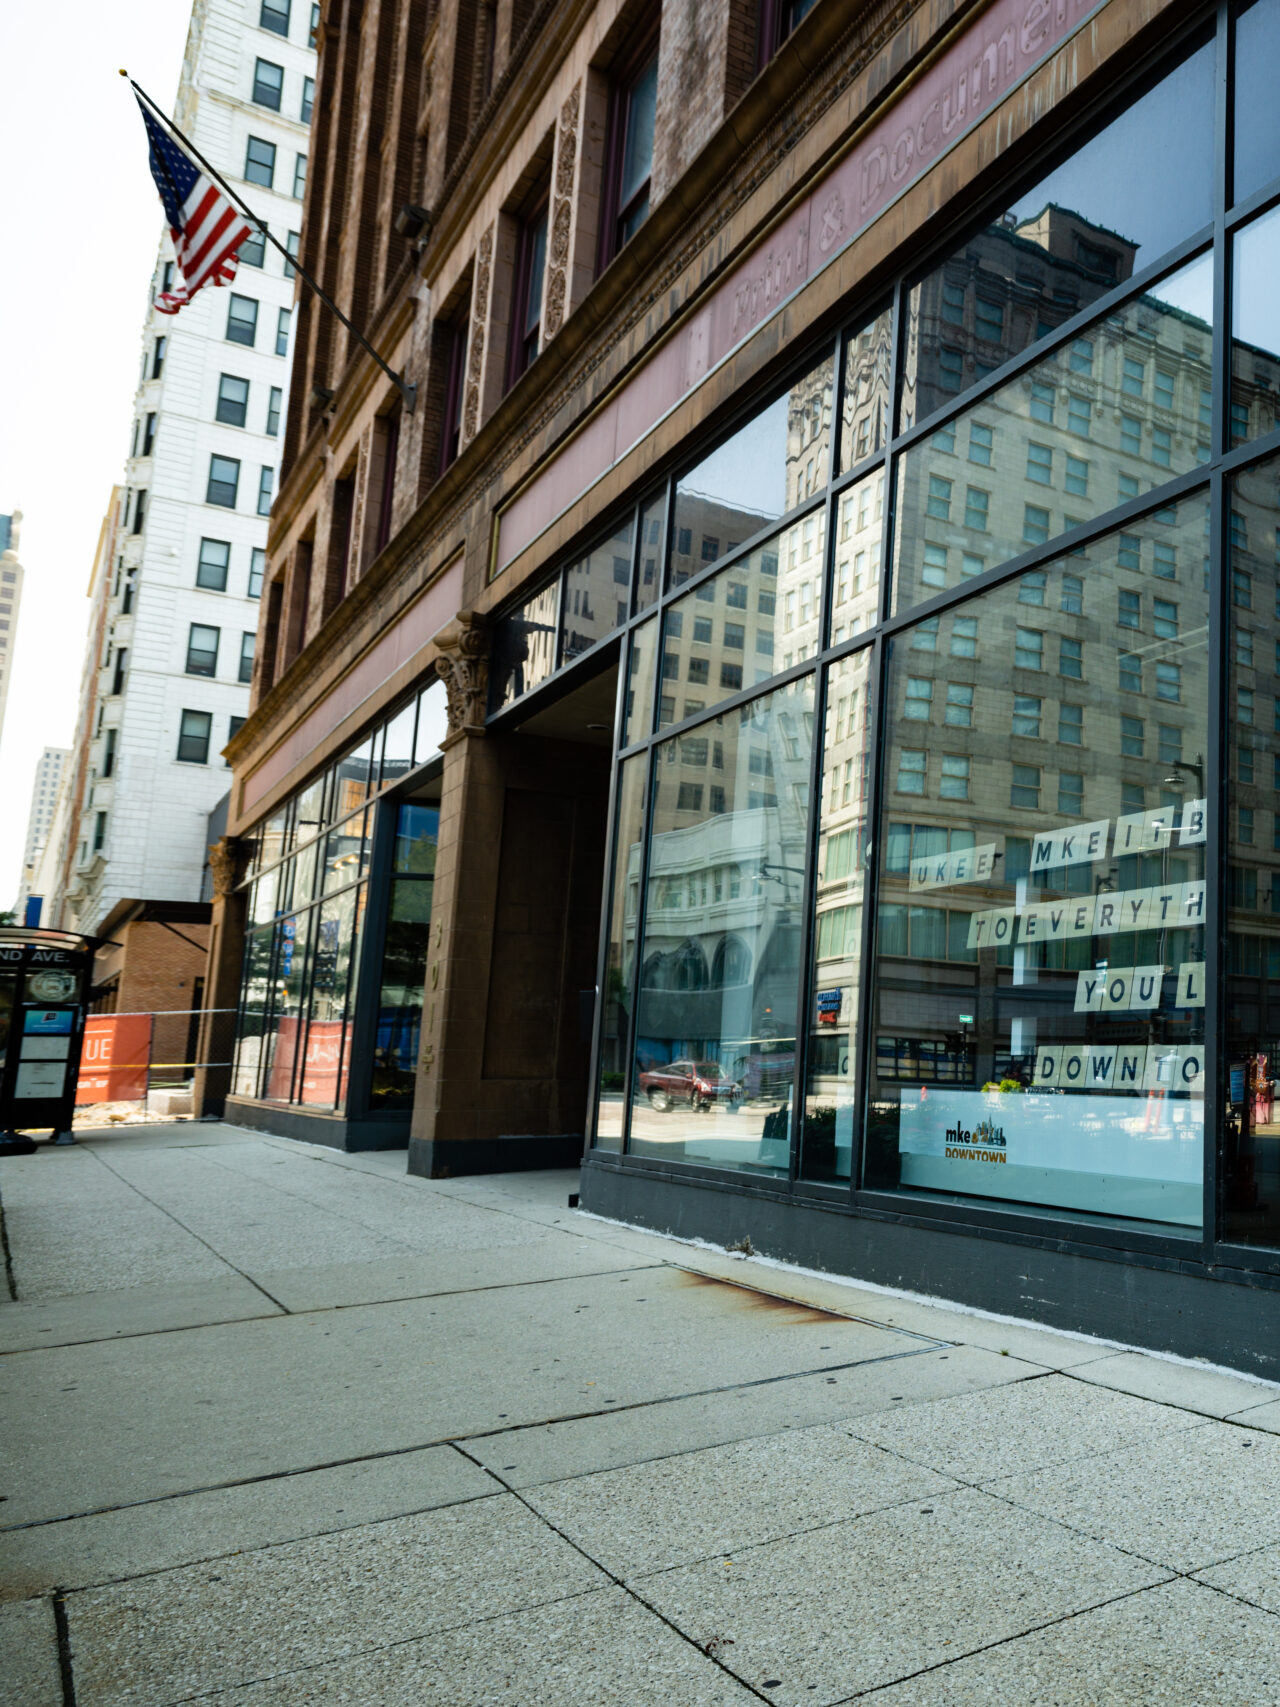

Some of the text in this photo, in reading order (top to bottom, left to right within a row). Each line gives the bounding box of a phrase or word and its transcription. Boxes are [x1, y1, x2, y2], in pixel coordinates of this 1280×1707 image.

[1035, 831, 1100, 863] MKE
[975, 918, 1007, 941] TO
[1085, 974, 1197, 1004] YOU L
[945, 1121, 971, 1143] mke
[945, 1147, 1007, 1164] DOWNTOWN
